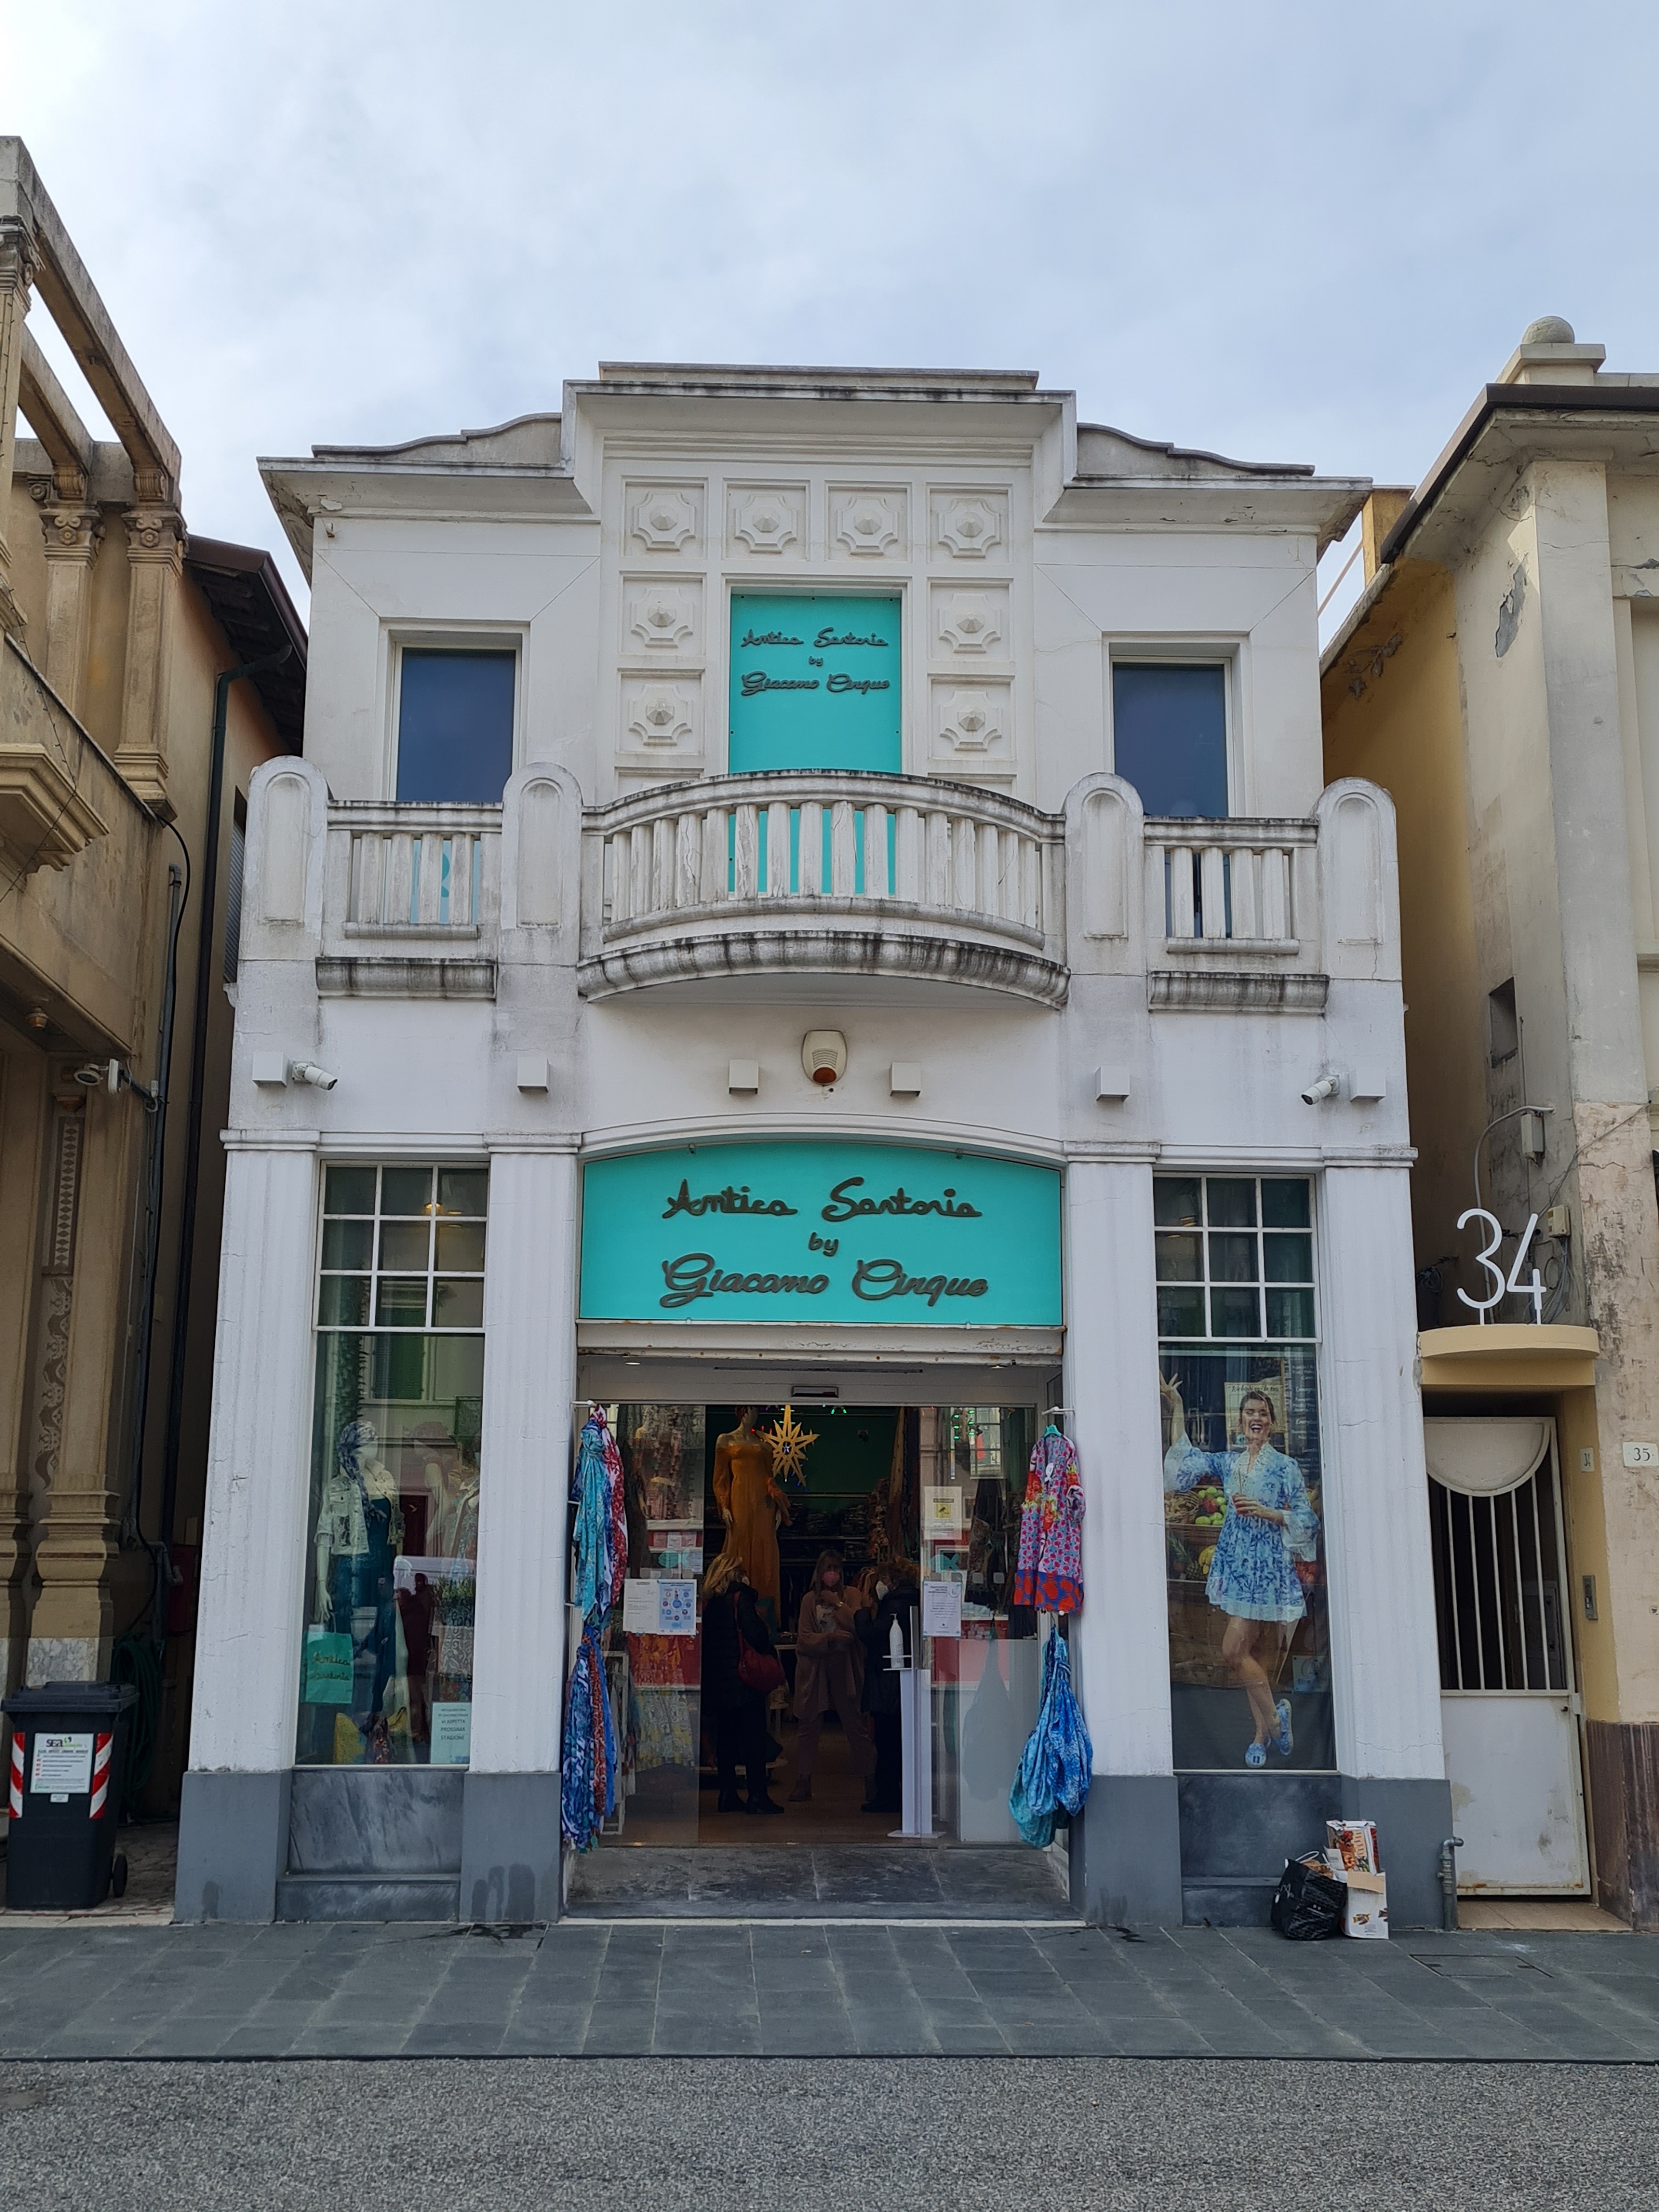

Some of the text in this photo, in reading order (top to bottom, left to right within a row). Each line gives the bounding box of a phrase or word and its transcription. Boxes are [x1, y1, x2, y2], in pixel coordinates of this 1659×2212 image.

[741, 627, 888, 648] Antica Sartoria
[809, 656, 823, 667] by
[741, 671, 890, 696] Giacomo Cinque
[661, 1176, 982, 1223] Antica Sartoria
[808, 1232, 839, 1257] by
[1456, 1208, 1547, 1310] 34
[660, 1252, 989, 1309] Giacomo Cinque
[1633, 1447, 1650, 1461] 35
